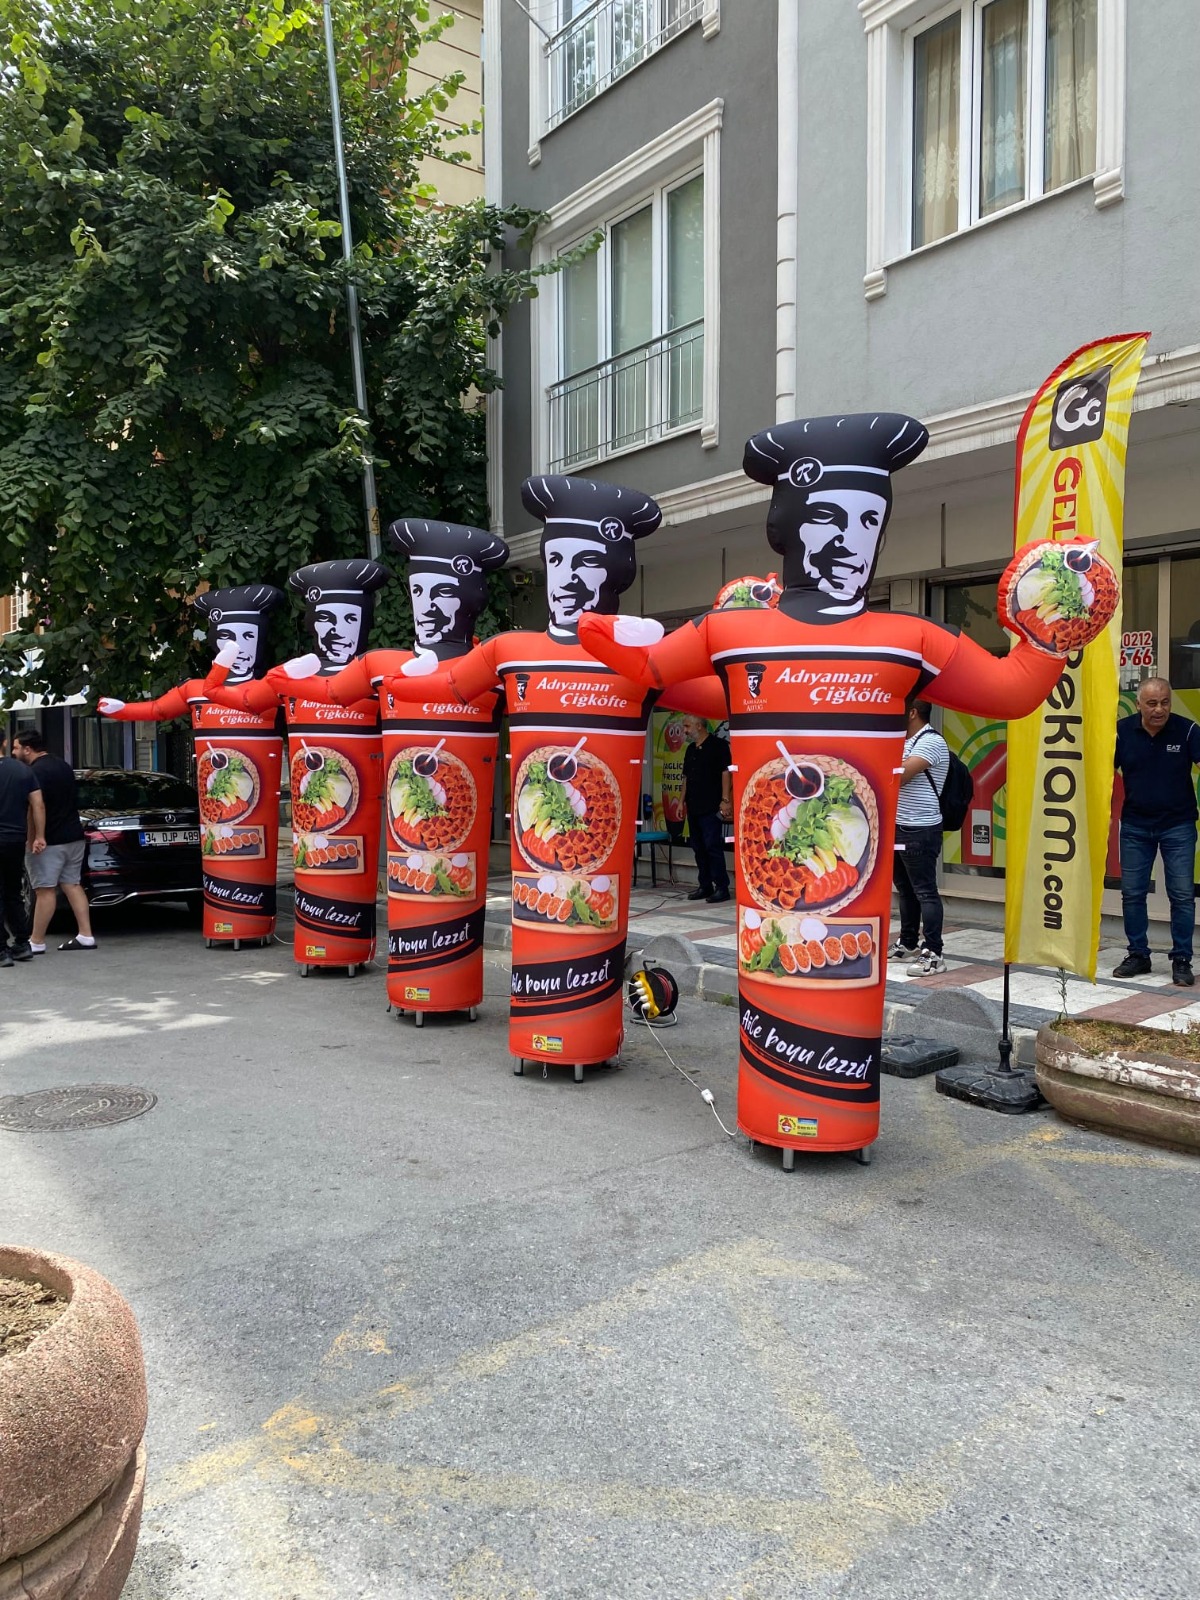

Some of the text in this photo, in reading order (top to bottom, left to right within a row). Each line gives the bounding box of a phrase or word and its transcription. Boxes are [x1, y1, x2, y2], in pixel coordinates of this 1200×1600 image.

[1122, 631, 1152, 647] 0212
[1132, 647, 1153, 667] 66
[535, 676, 610, 692] Adıyaman
[775, 667, 873, 686] Adıyaman
[560, 692, 628, 708] Çiğköfte
[809, 686, 892, 705] Çiğköfte
[219, 714, 264, 726] Çiğköfte
[315, 709, 365, 720] Çiğköfte
[145, 831, 199, 843] 34 DJP 489
[231, 887, 264, 905] lezzet
[325, 906, 362, 926] lezzet
[432, 922, 470, 949] lezzet
[566, 959, 611, 990] lezzet
[742, 1009, 762, 1038] Aile
[817, 1046, 872, 1080] lezzet
